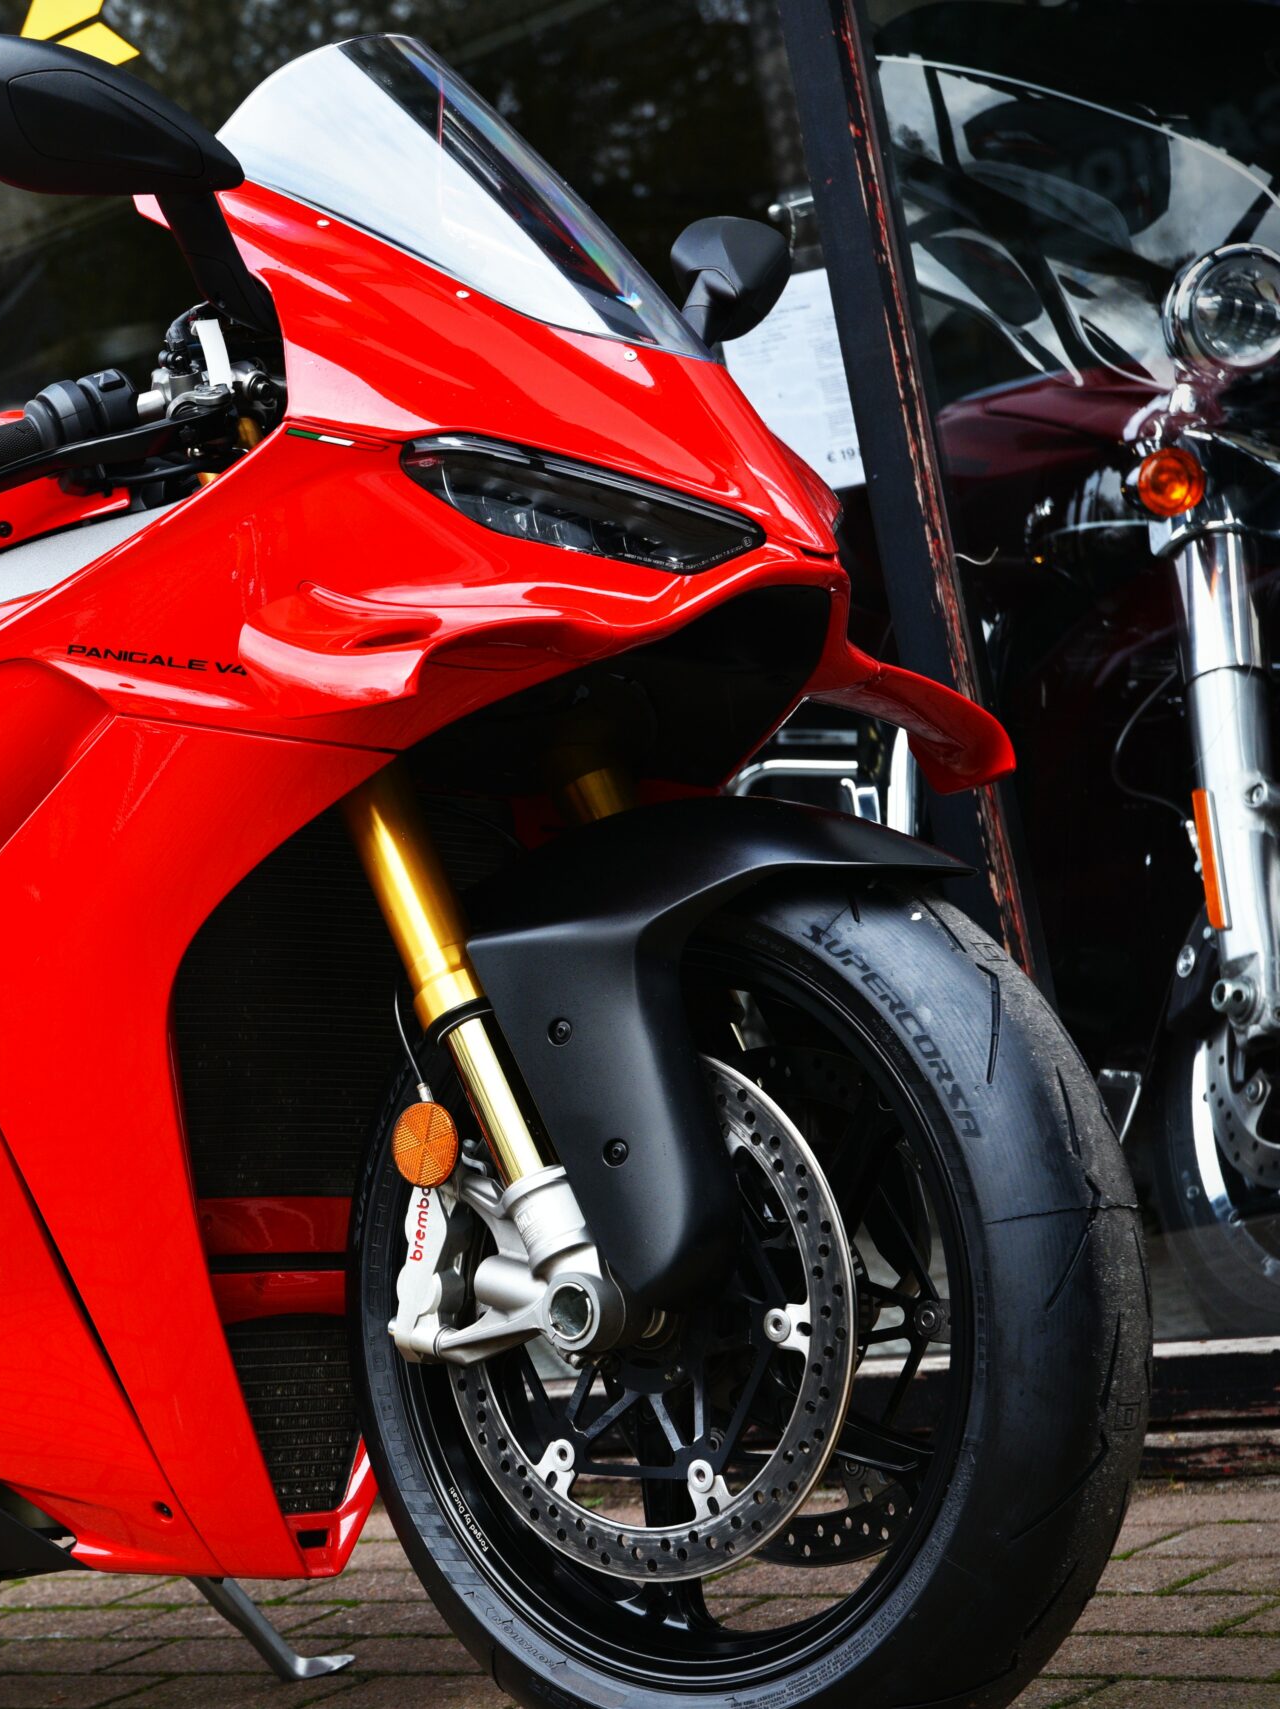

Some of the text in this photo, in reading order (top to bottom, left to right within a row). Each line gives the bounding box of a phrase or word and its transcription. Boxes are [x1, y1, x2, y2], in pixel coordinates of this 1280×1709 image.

[66, 644, 247, 677] PANIGALE V4
[801, 922, 982, 1139] SUPERCORSA
[448, 1486, 490, 1553] Forged by Ducati
